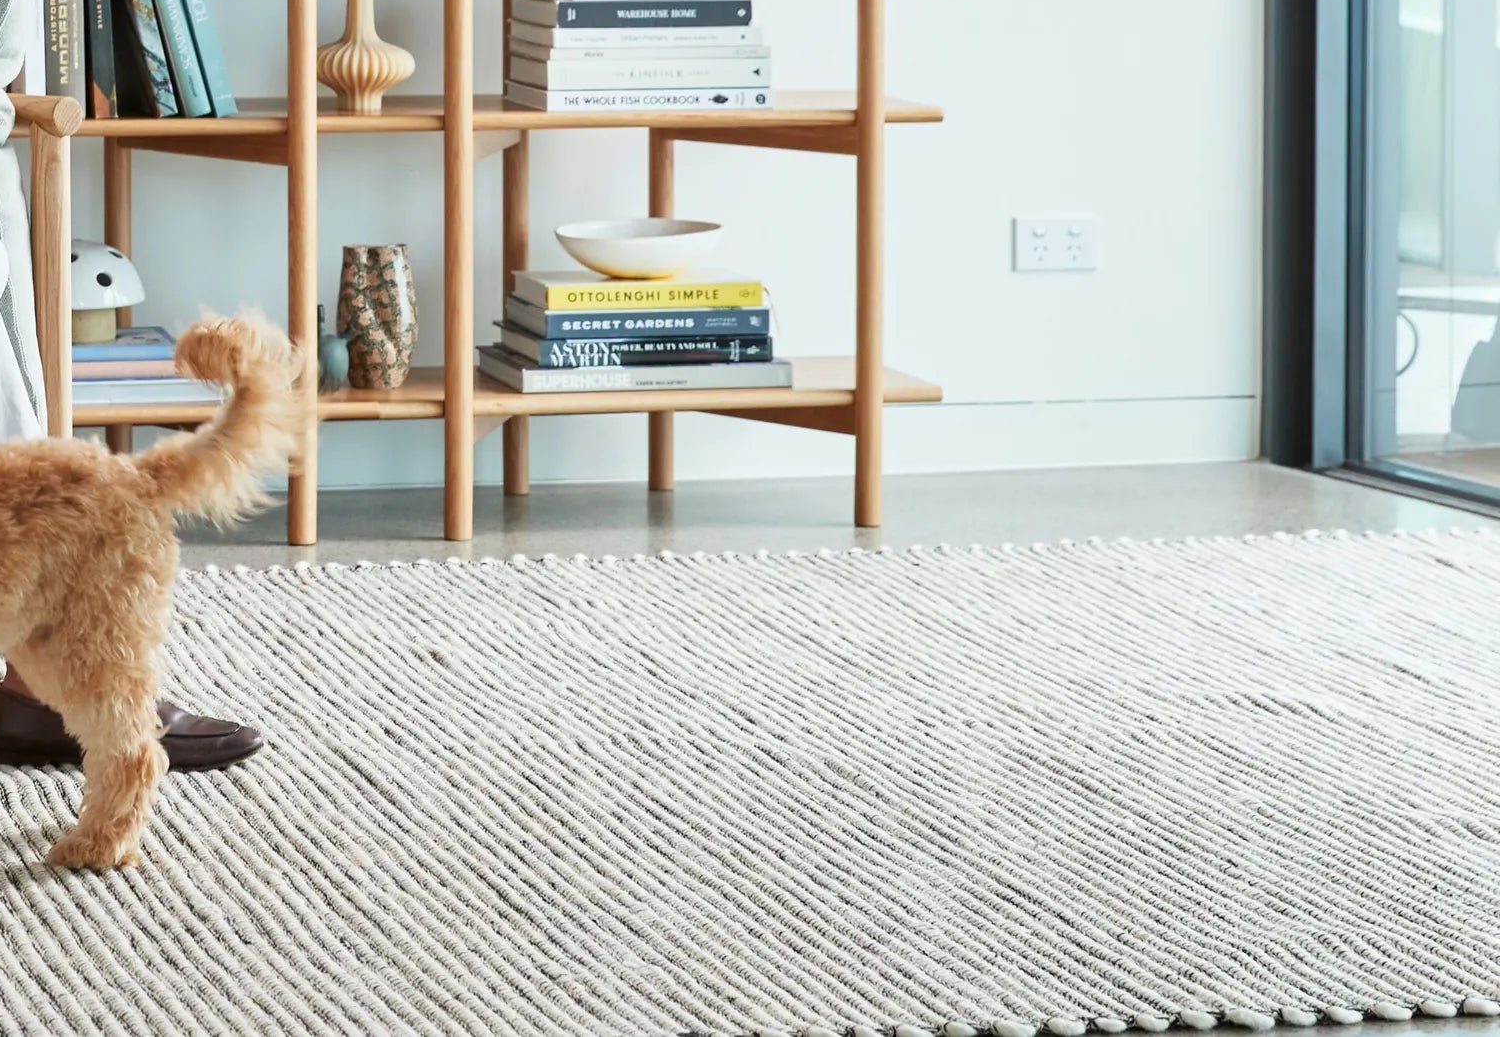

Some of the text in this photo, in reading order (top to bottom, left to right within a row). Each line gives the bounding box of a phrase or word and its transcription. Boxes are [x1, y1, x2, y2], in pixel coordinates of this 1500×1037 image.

[617, 9, 697, 19] WAREHOUSE HOME
[52, 44, 59, 52] A
[564, 94, 701, 106] THE WHOLE FISH COOKBOOK
[567, 289, 720, 303] OTTOLENGHI SIMPLE
[562, 318, 695, 331] SECRET GARDENS
[550, 341, 610, 354] ASTON
[611, 342, 719, 353] POWER, BEAUTY AND SOUL
[550, 352, 622, 366] MARTIN
[532, 372, 632, 388] SUPERHOUSE
